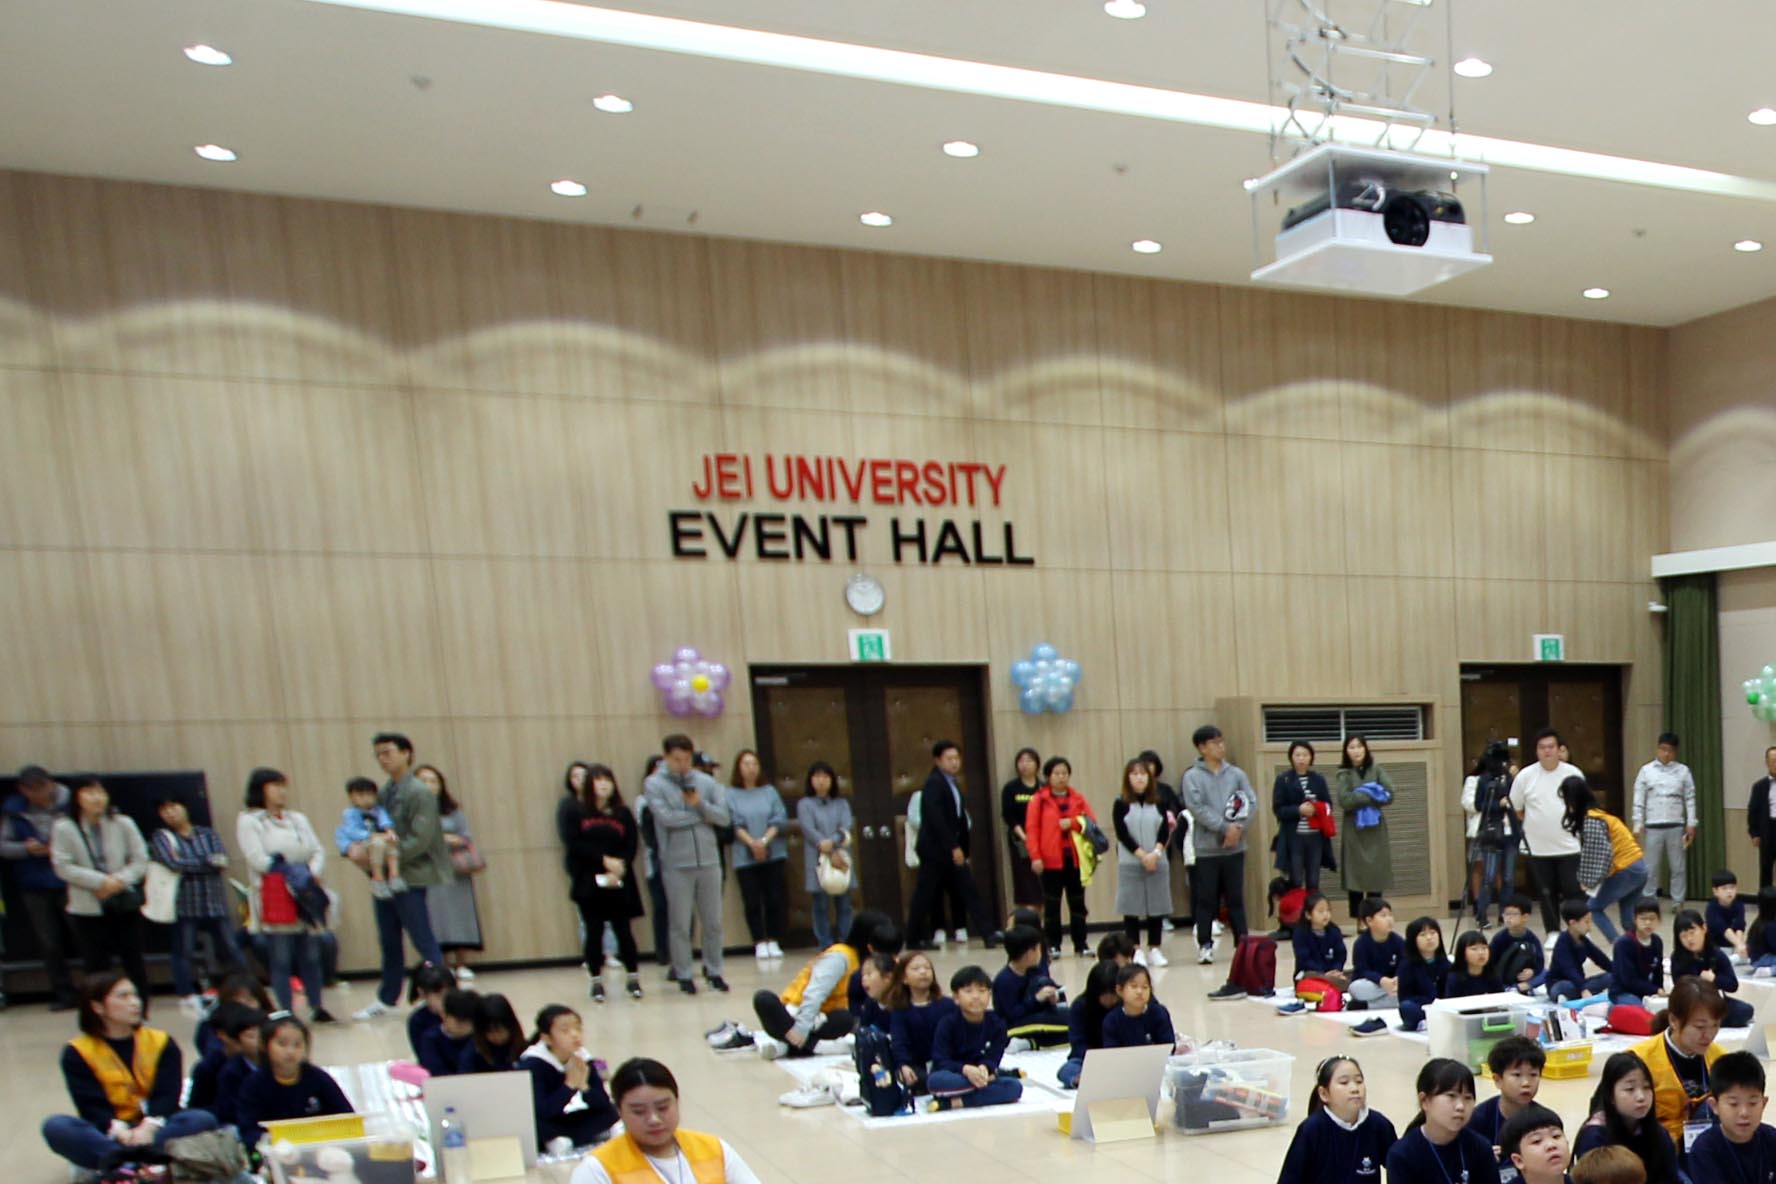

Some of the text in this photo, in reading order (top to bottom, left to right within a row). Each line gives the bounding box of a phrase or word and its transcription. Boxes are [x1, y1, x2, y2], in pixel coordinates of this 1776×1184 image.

[692, 454, 1006, 506] JEI UNIVERSITY
[669, 510, 1034, 566] EVENT HALL
